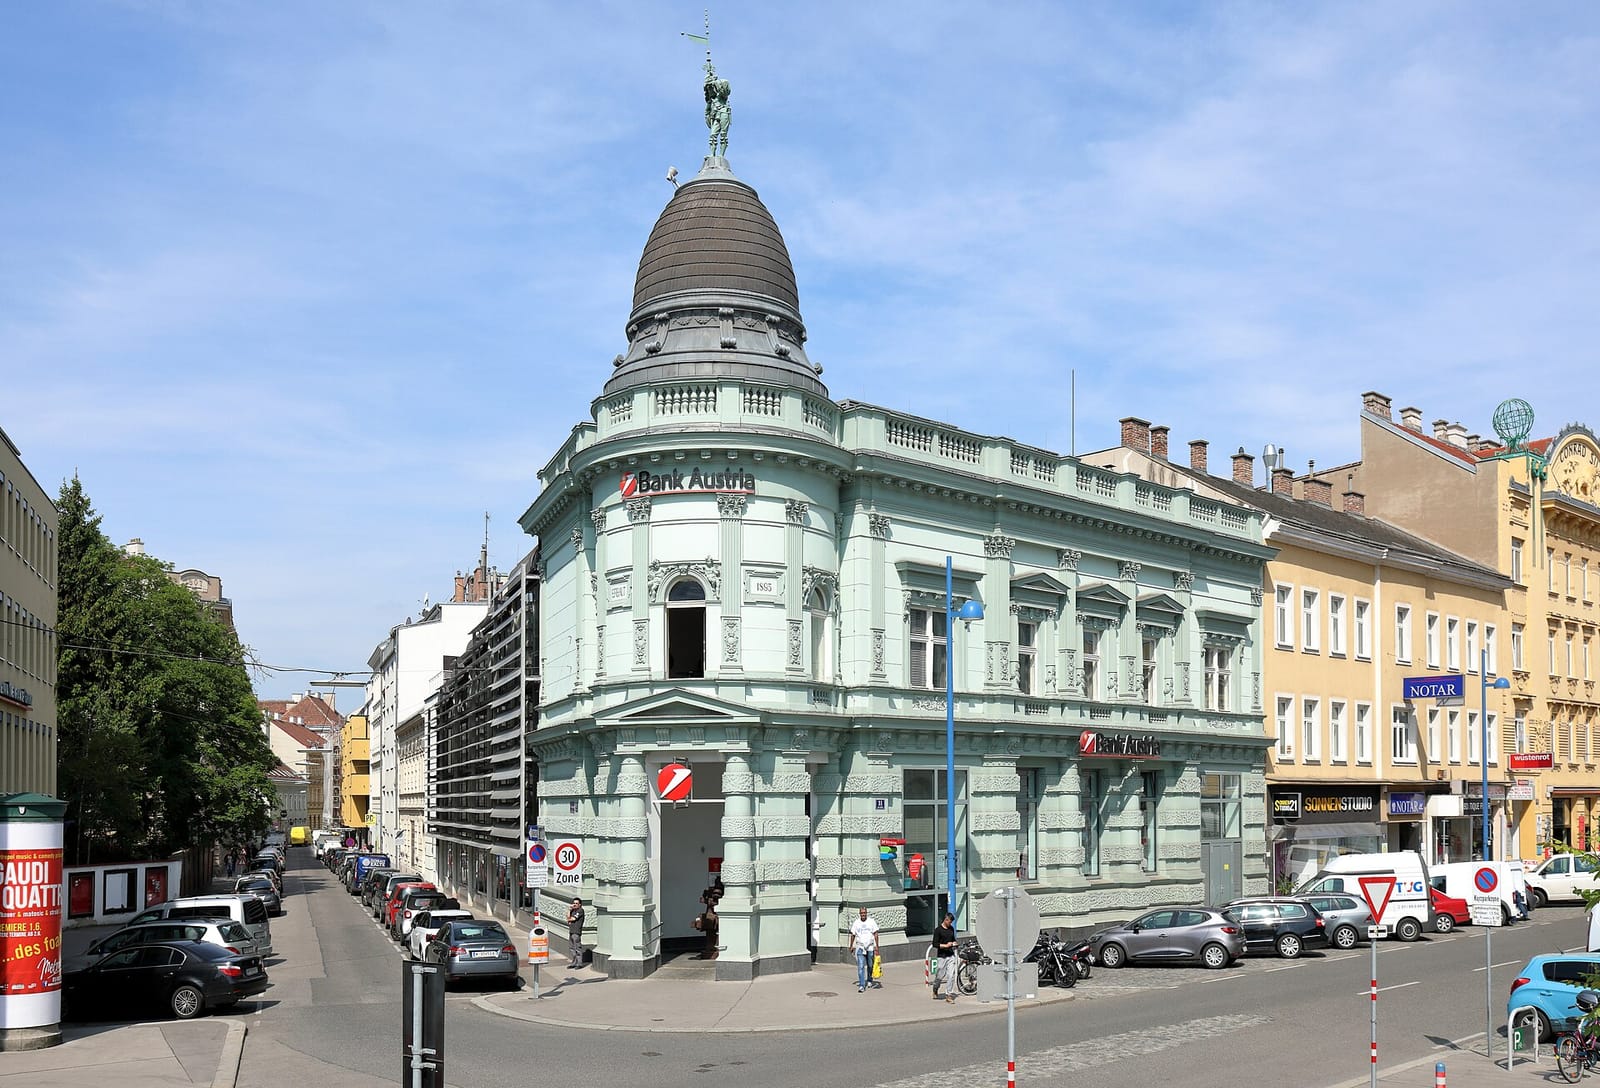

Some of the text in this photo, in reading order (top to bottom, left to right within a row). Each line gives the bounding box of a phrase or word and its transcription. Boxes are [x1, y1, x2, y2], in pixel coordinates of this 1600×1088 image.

[1560, 443, 1586, 463] CONRAD
[638, 467, 755, 492] Bank Austria
[1410, 684, 1456, 697] NOTAR
[1096, 732, 1160, 755] Bank Austria
[1304, 796, 1373, 812] SONNENSTUDIO
[1396, 800, 1418, 813] NOTAR
[561, 850, 575, 863] 30
[556, 872, 580, 884] Zone
[1514, 1031, 1521, 1050] P
